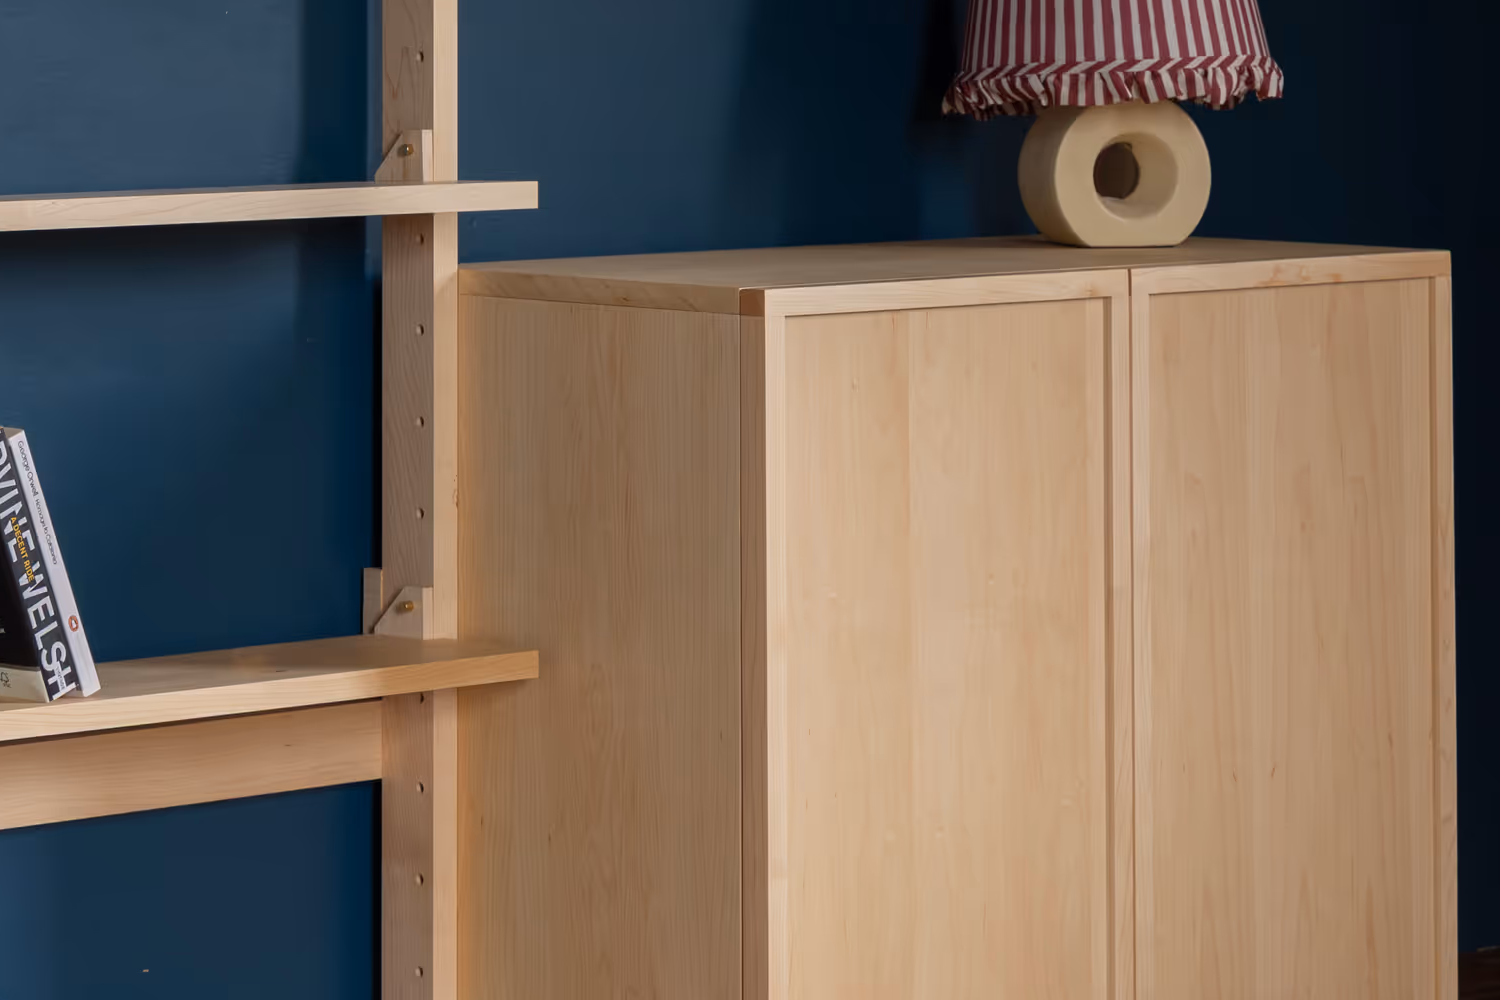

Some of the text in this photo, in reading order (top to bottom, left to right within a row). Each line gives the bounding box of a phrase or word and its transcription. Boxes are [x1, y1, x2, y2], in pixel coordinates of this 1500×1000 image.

[17, 440, 39, 498] George Orwell
[10, 516, 35, 582] A DECENT RIDE
[18, 560, 77, 701] WELSH
